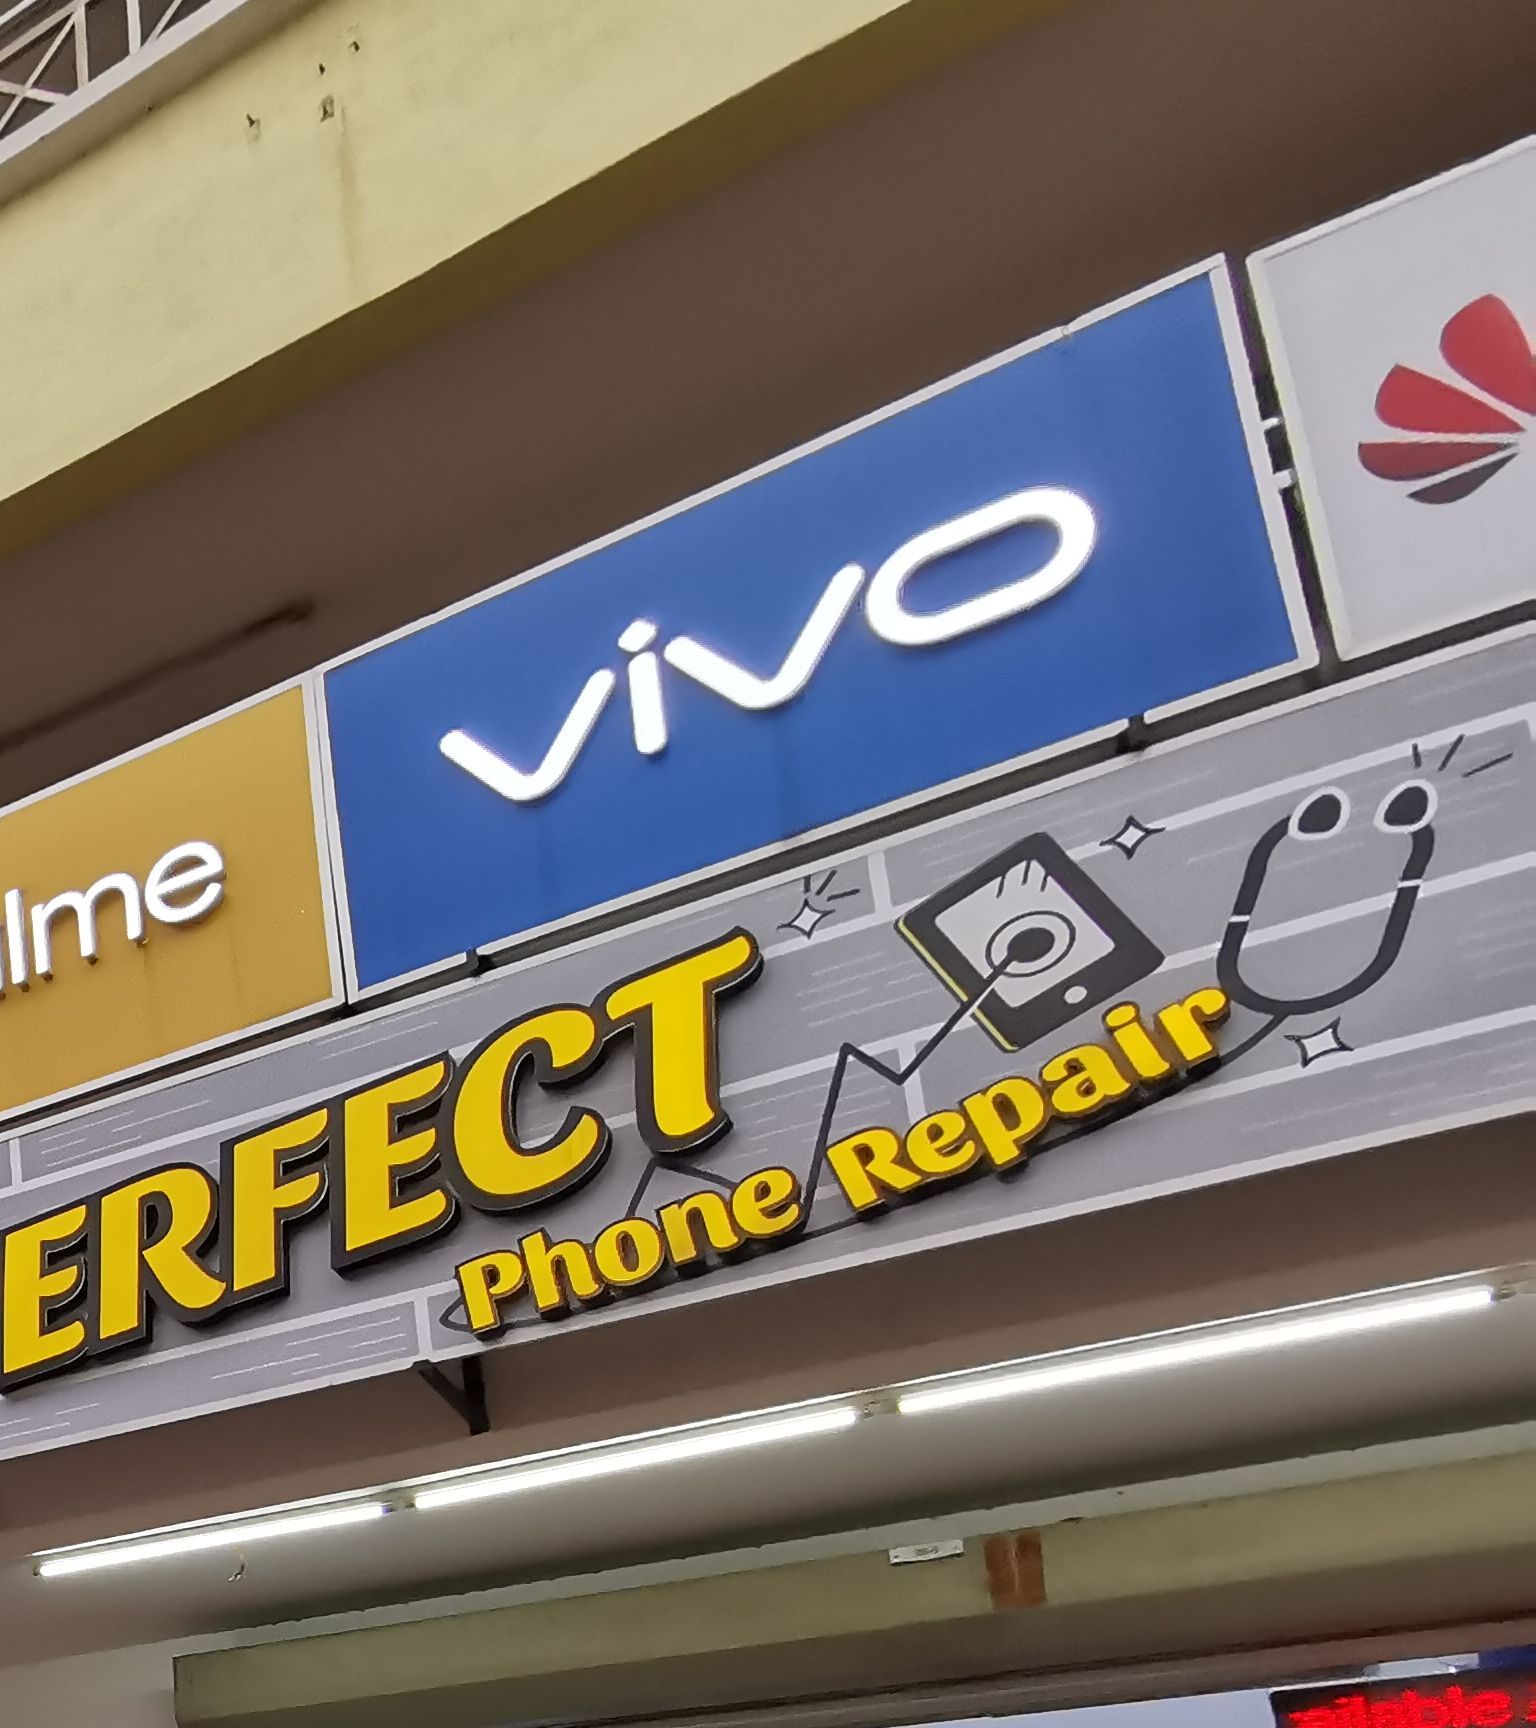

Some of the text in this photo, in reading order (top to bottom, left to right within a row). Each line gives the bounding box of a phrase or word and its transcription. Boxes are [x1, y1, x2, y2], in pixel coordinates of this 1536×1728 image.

[439, 484, 1098, 803] vivo
[459, 984, 1232, 1339] Phone Repair
